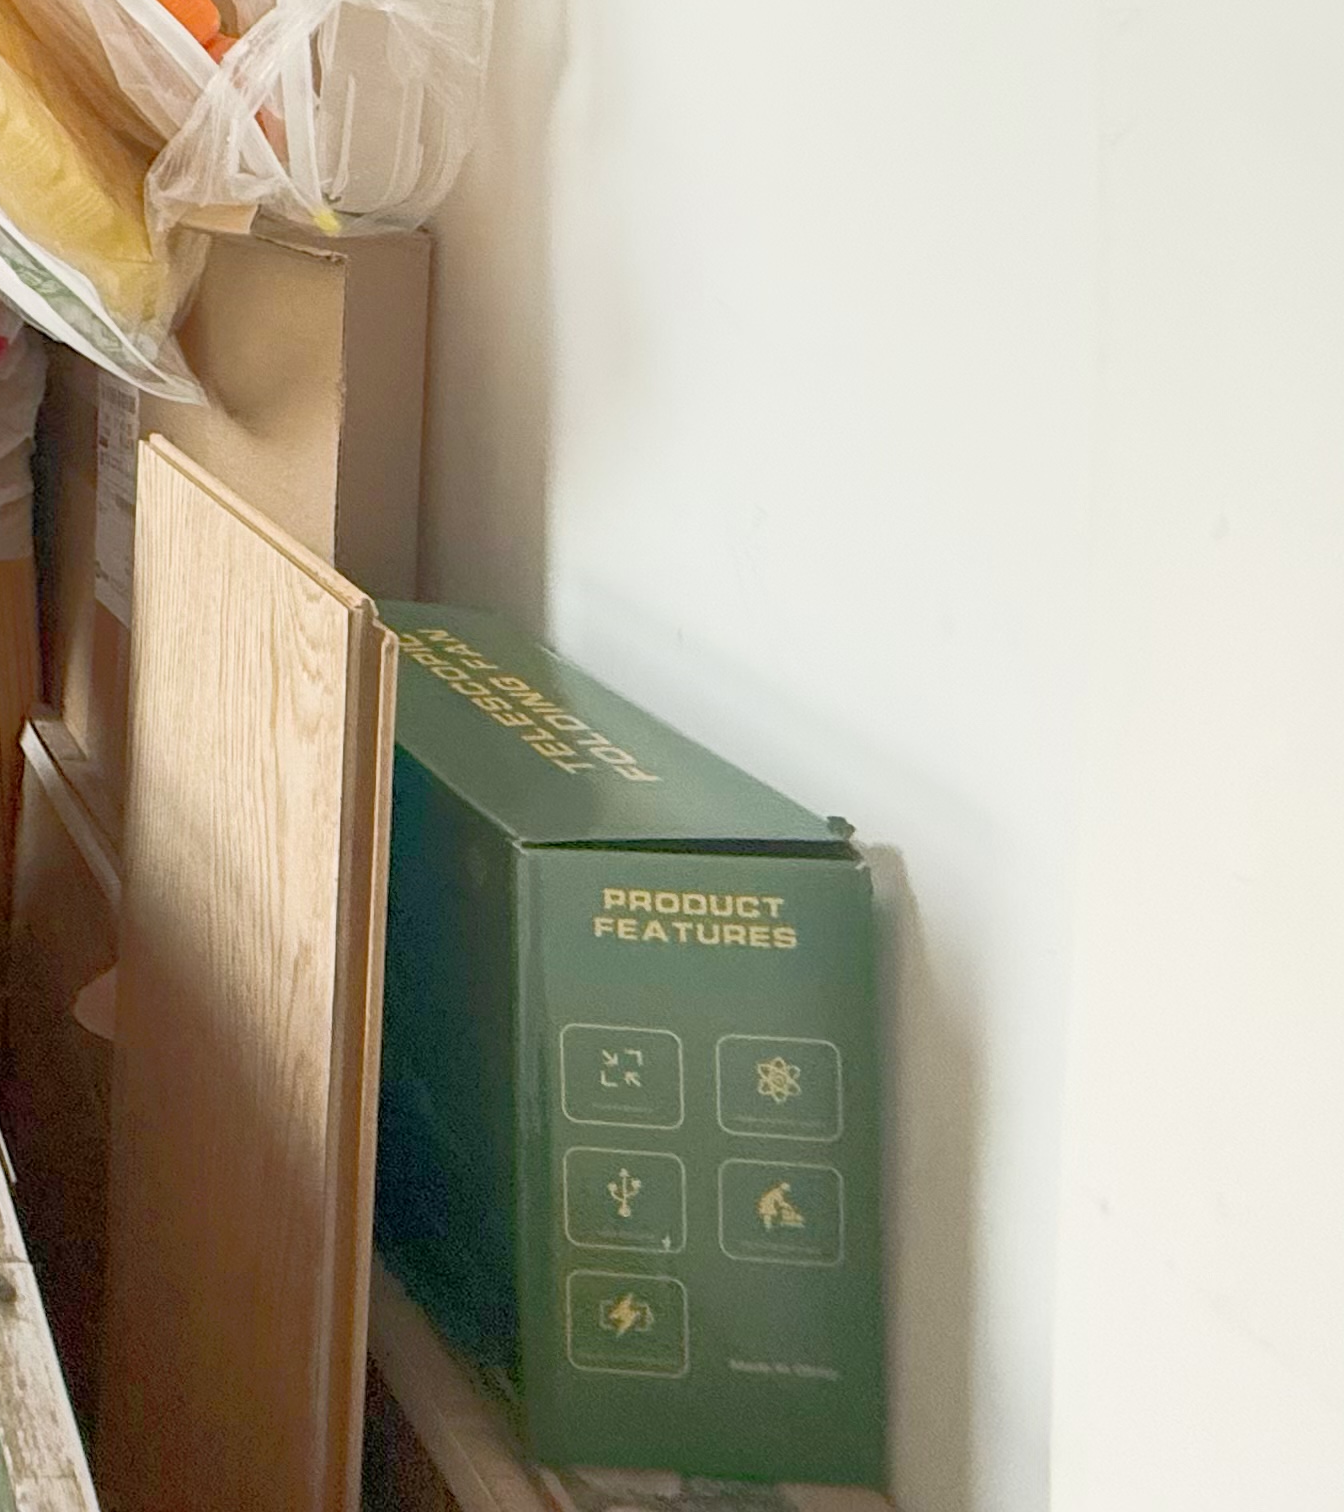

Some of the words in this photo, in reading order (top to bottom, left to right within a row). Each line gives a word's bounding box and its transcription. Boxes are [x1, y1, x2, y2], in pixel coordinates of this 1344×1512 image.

[416, 627, 500, 671] FAN
[398, 631, 597, 775] TELESCOPIC
[488, 676, 662, 783] FOLDING
[601, 887, 785, 920] PRODUCT
[591, 917, 799, 950] FEATURES
